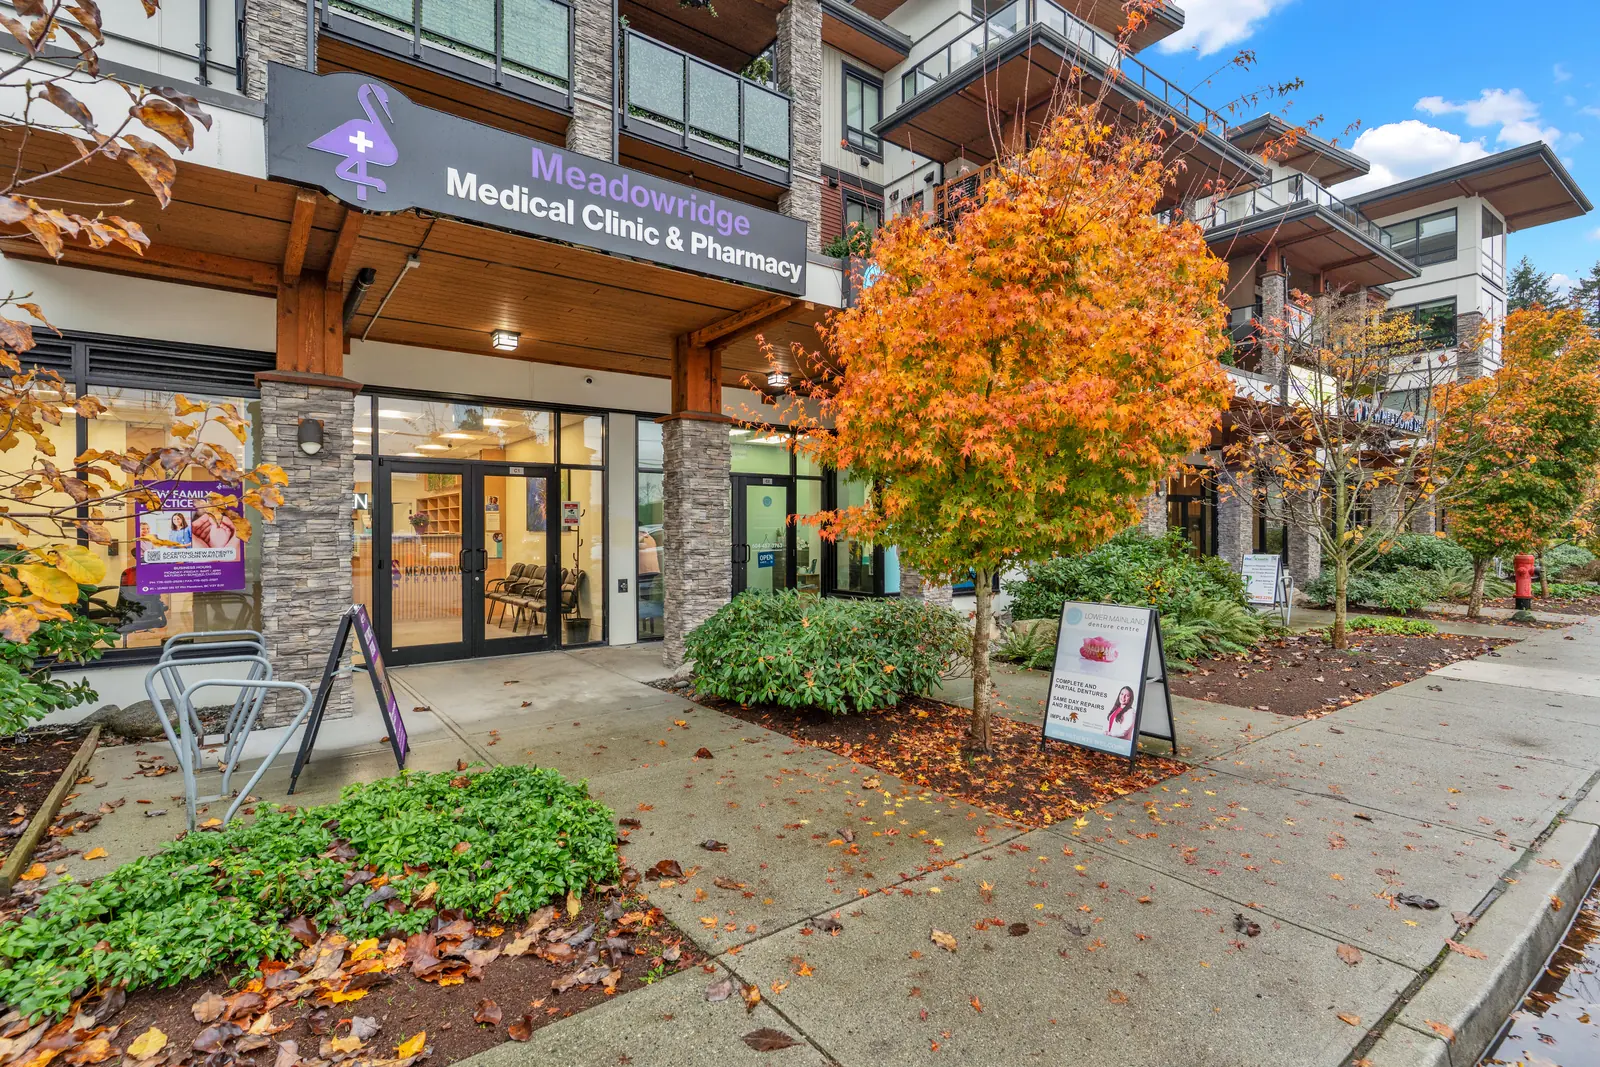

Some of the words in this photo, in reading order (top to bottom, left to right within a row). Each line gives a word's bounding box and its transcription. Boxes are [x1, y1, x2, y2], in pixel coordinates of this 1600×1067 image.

[531, 147, 750, 236] Meadowridge
[447, 167, 574, 225] Medical
[582, 204, 659, 246] Clinic
[665, 226, 684, 252] &
[691, 231, 802, 284] Pharmacy
[173, 490, 213, 499] FAMILY
[405, 565, 462, 577] MEADOWRI
[405, 575, 457, 583] PHARMA
[1084, 612, 1108, 621] LOWER
[1109, 615, 1146, 625] MAINLAND
[1088, 621, 1114, 629] denture
[1055, 678, 1084, 687] COMPLETE
[1054, 684, 1076, 693] PARTIAL
[1077, 688, 1108, 698] DENTURES
[1064, 704, 1087, 713] RELINES
[1080, 701, 1105, 710] REPAIRS
